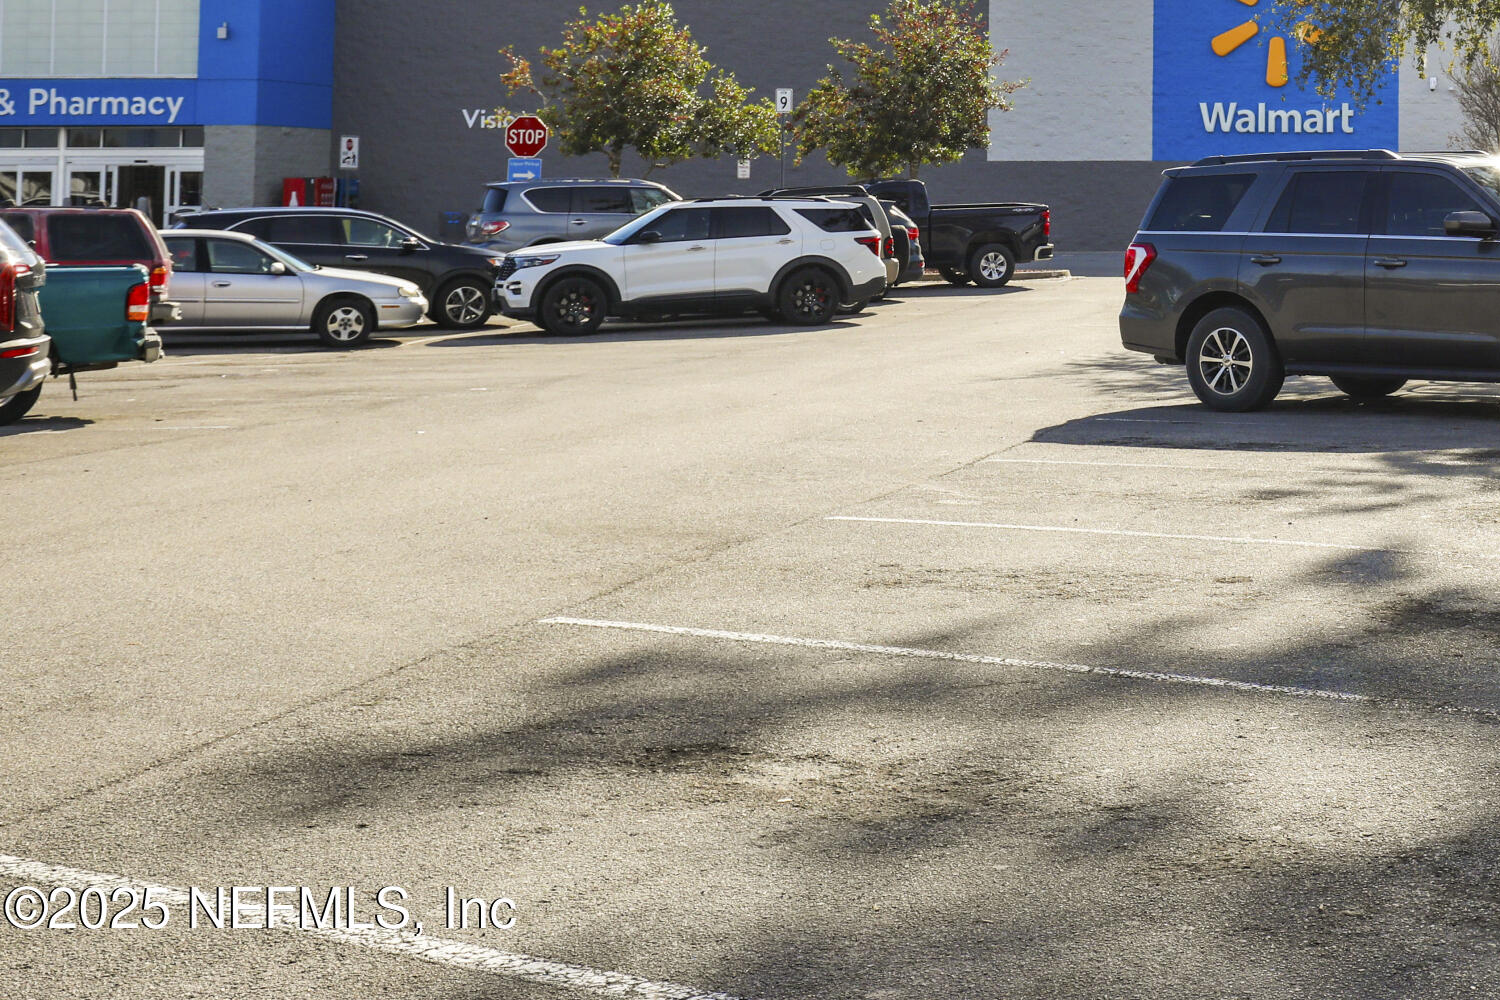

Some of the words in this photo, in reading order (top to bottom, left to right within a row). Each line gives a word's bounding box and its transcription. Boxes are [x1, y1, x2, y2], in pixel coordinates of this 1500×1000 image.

[0, 88, 16, 116] &
[28, 88, 184, 124] Pharmacy
[780, 96, 788, 109] 9
[1199, 102, 1354, 133] Walmart
[508, 129, 545, 145] STOP
